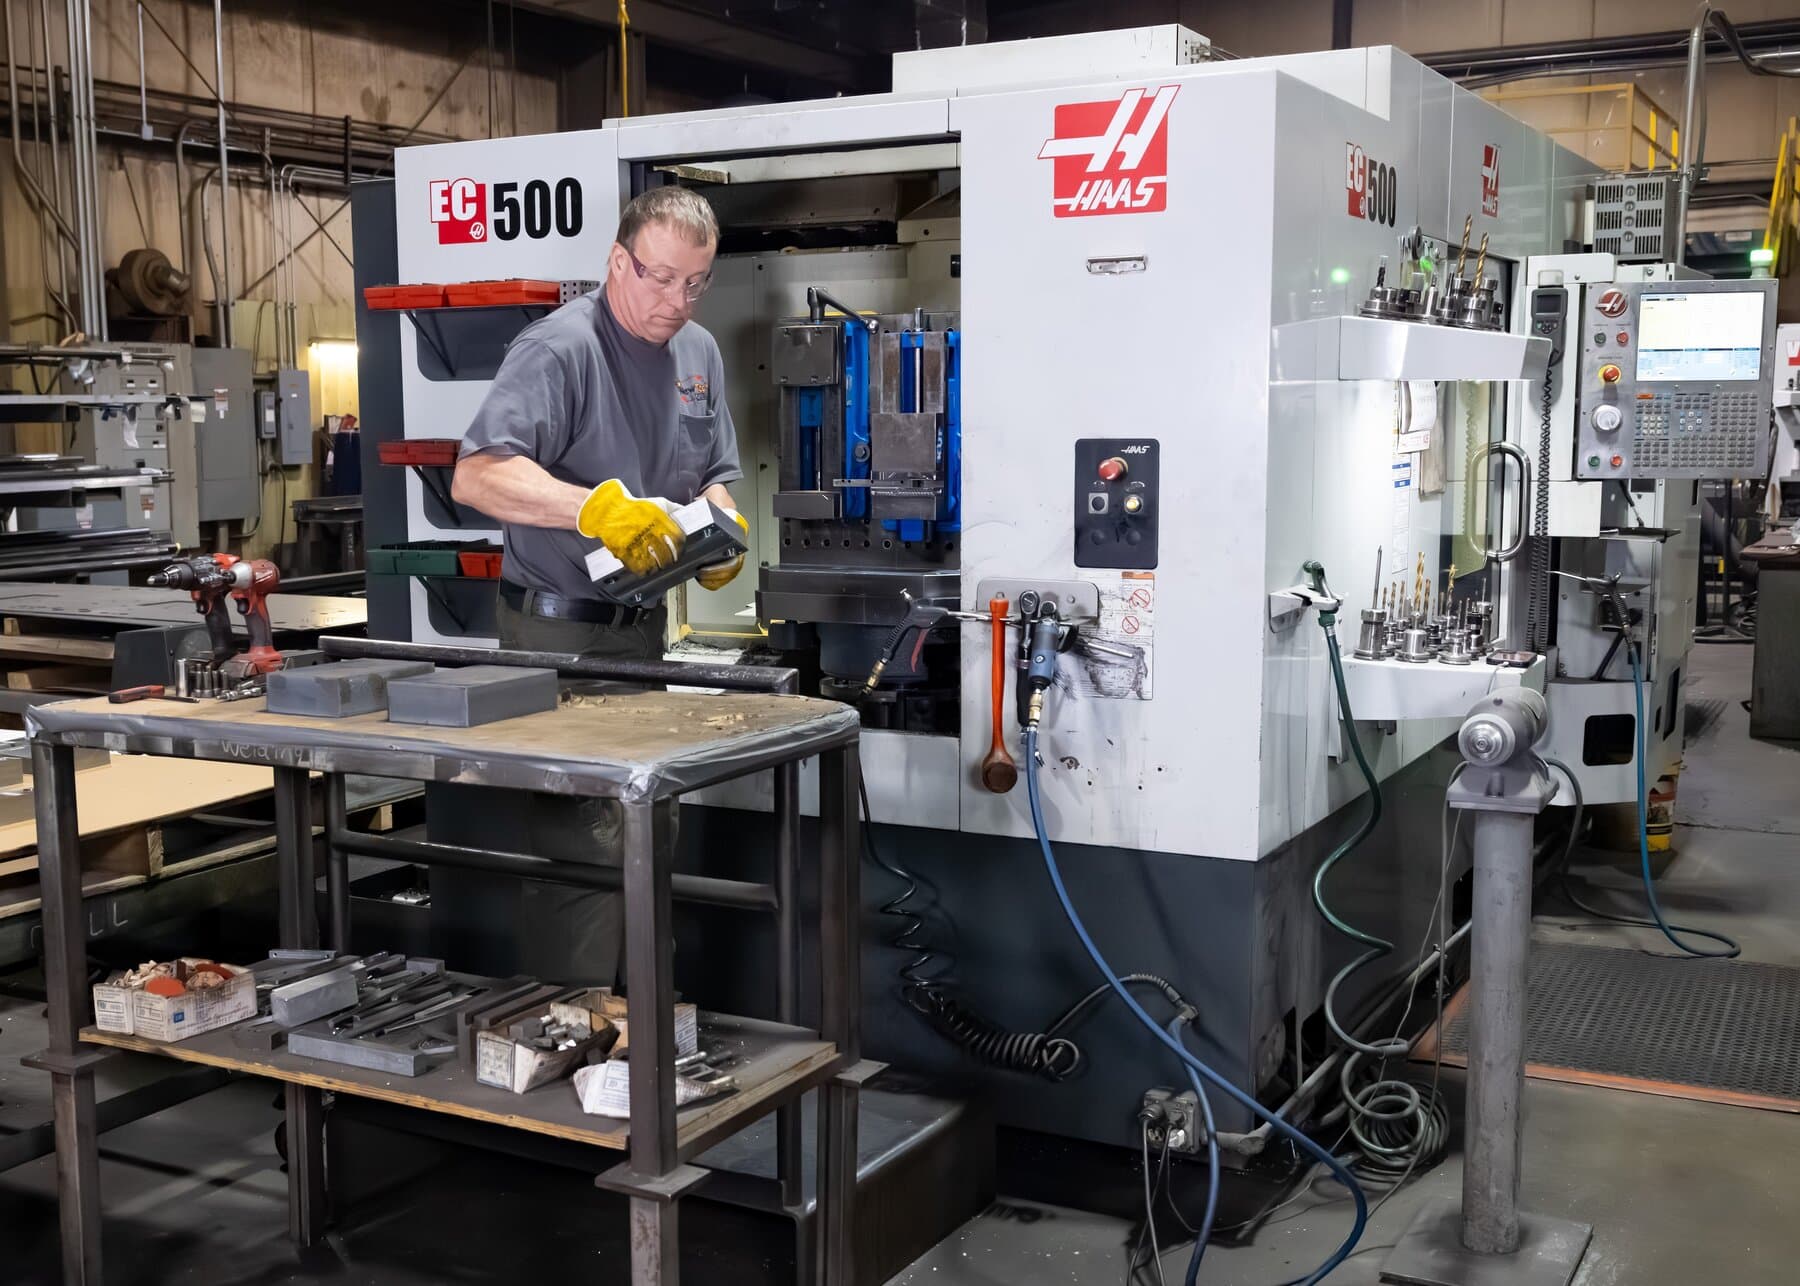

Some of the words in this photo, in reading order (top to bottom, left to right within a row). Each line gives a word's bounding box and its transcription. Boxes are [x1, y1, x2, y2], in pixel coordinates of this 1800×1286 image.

[430, 177, 477, 223] EC
[493, 177, 583, 241] 500
[1054, 176, 1167, 212] HAAS
[1346, 142, 1364, 192] EC
[1368, 158, 1397, 227] 500
[1120, 445, 1150, 454] HAAS
